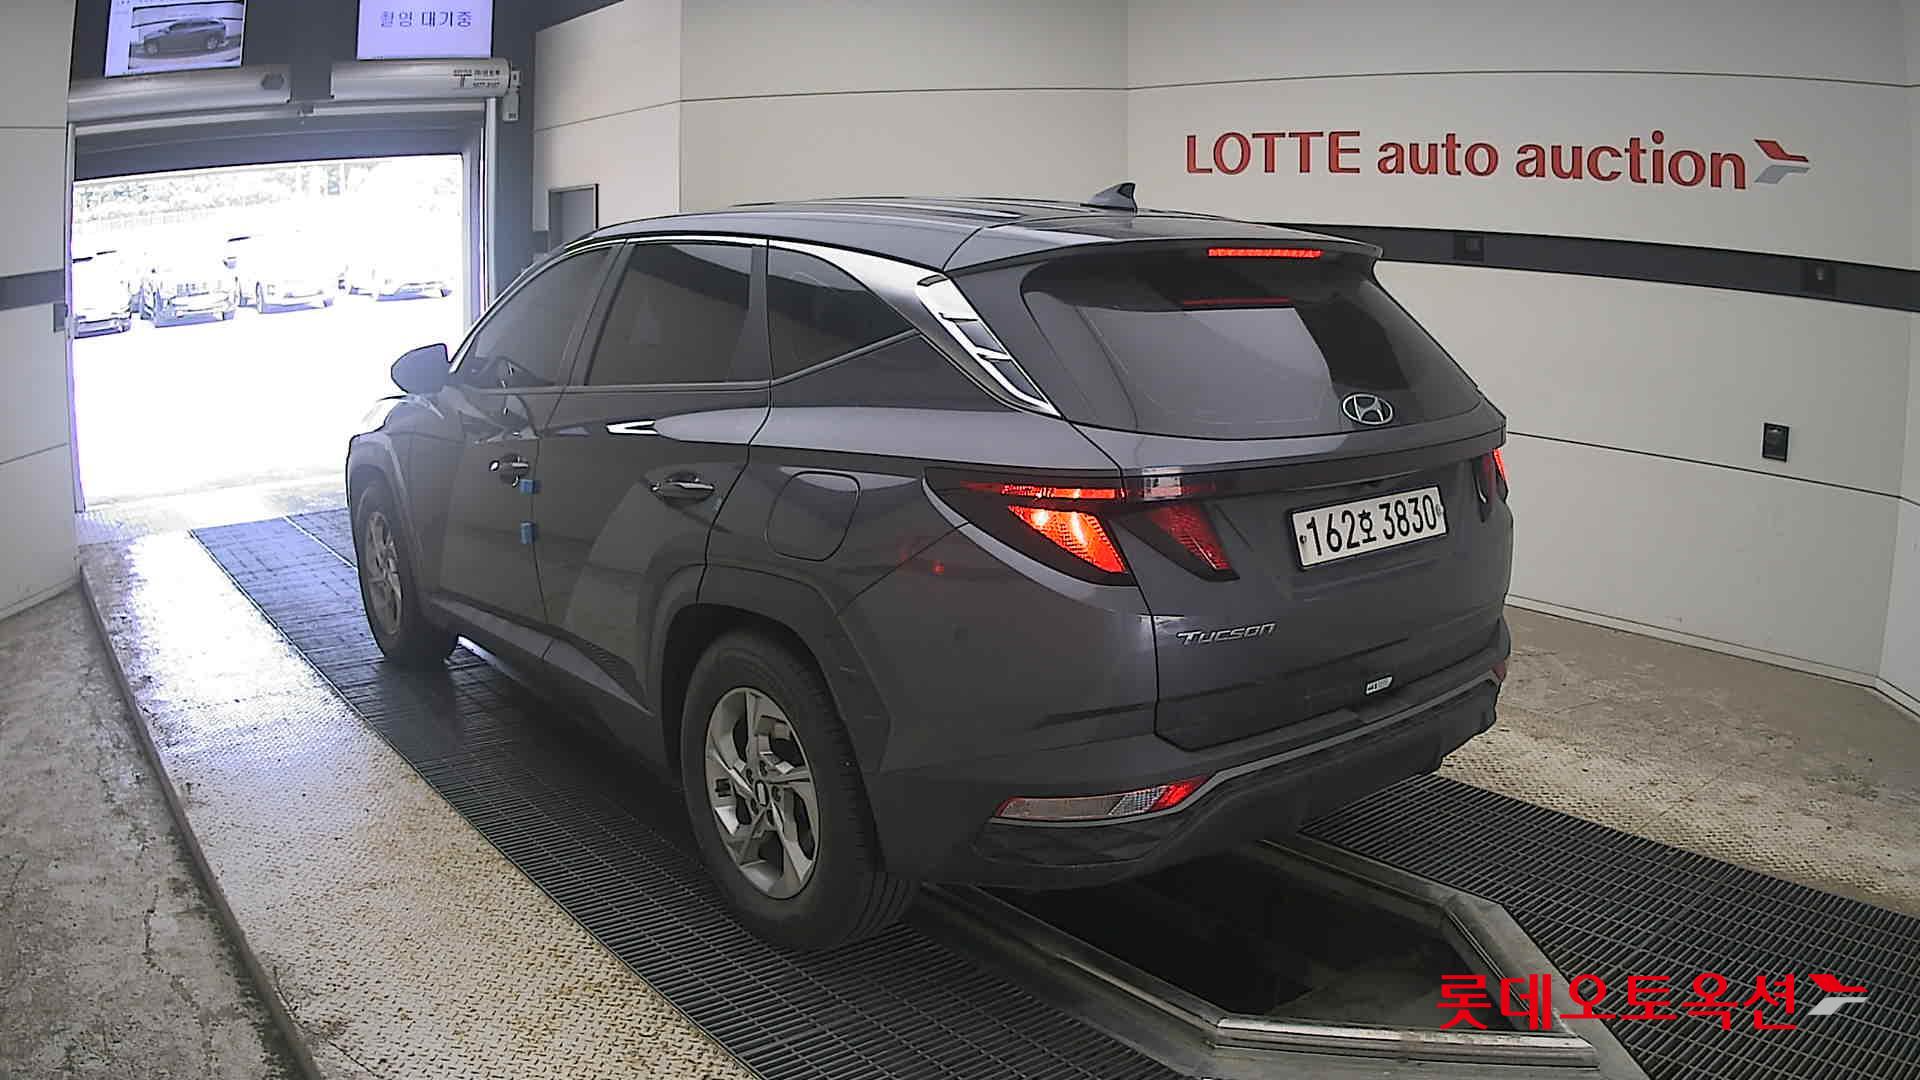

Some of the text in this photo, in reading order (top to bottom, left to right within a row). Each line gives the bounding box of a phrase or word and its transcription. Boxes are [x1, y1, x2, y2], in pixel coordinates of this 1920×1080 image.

[421, 10, 473, 28] 대기중
[1186, 131, 1746, 189] LOTTE auto auction
[1306, 494, 1437, 556] 162호 3830
